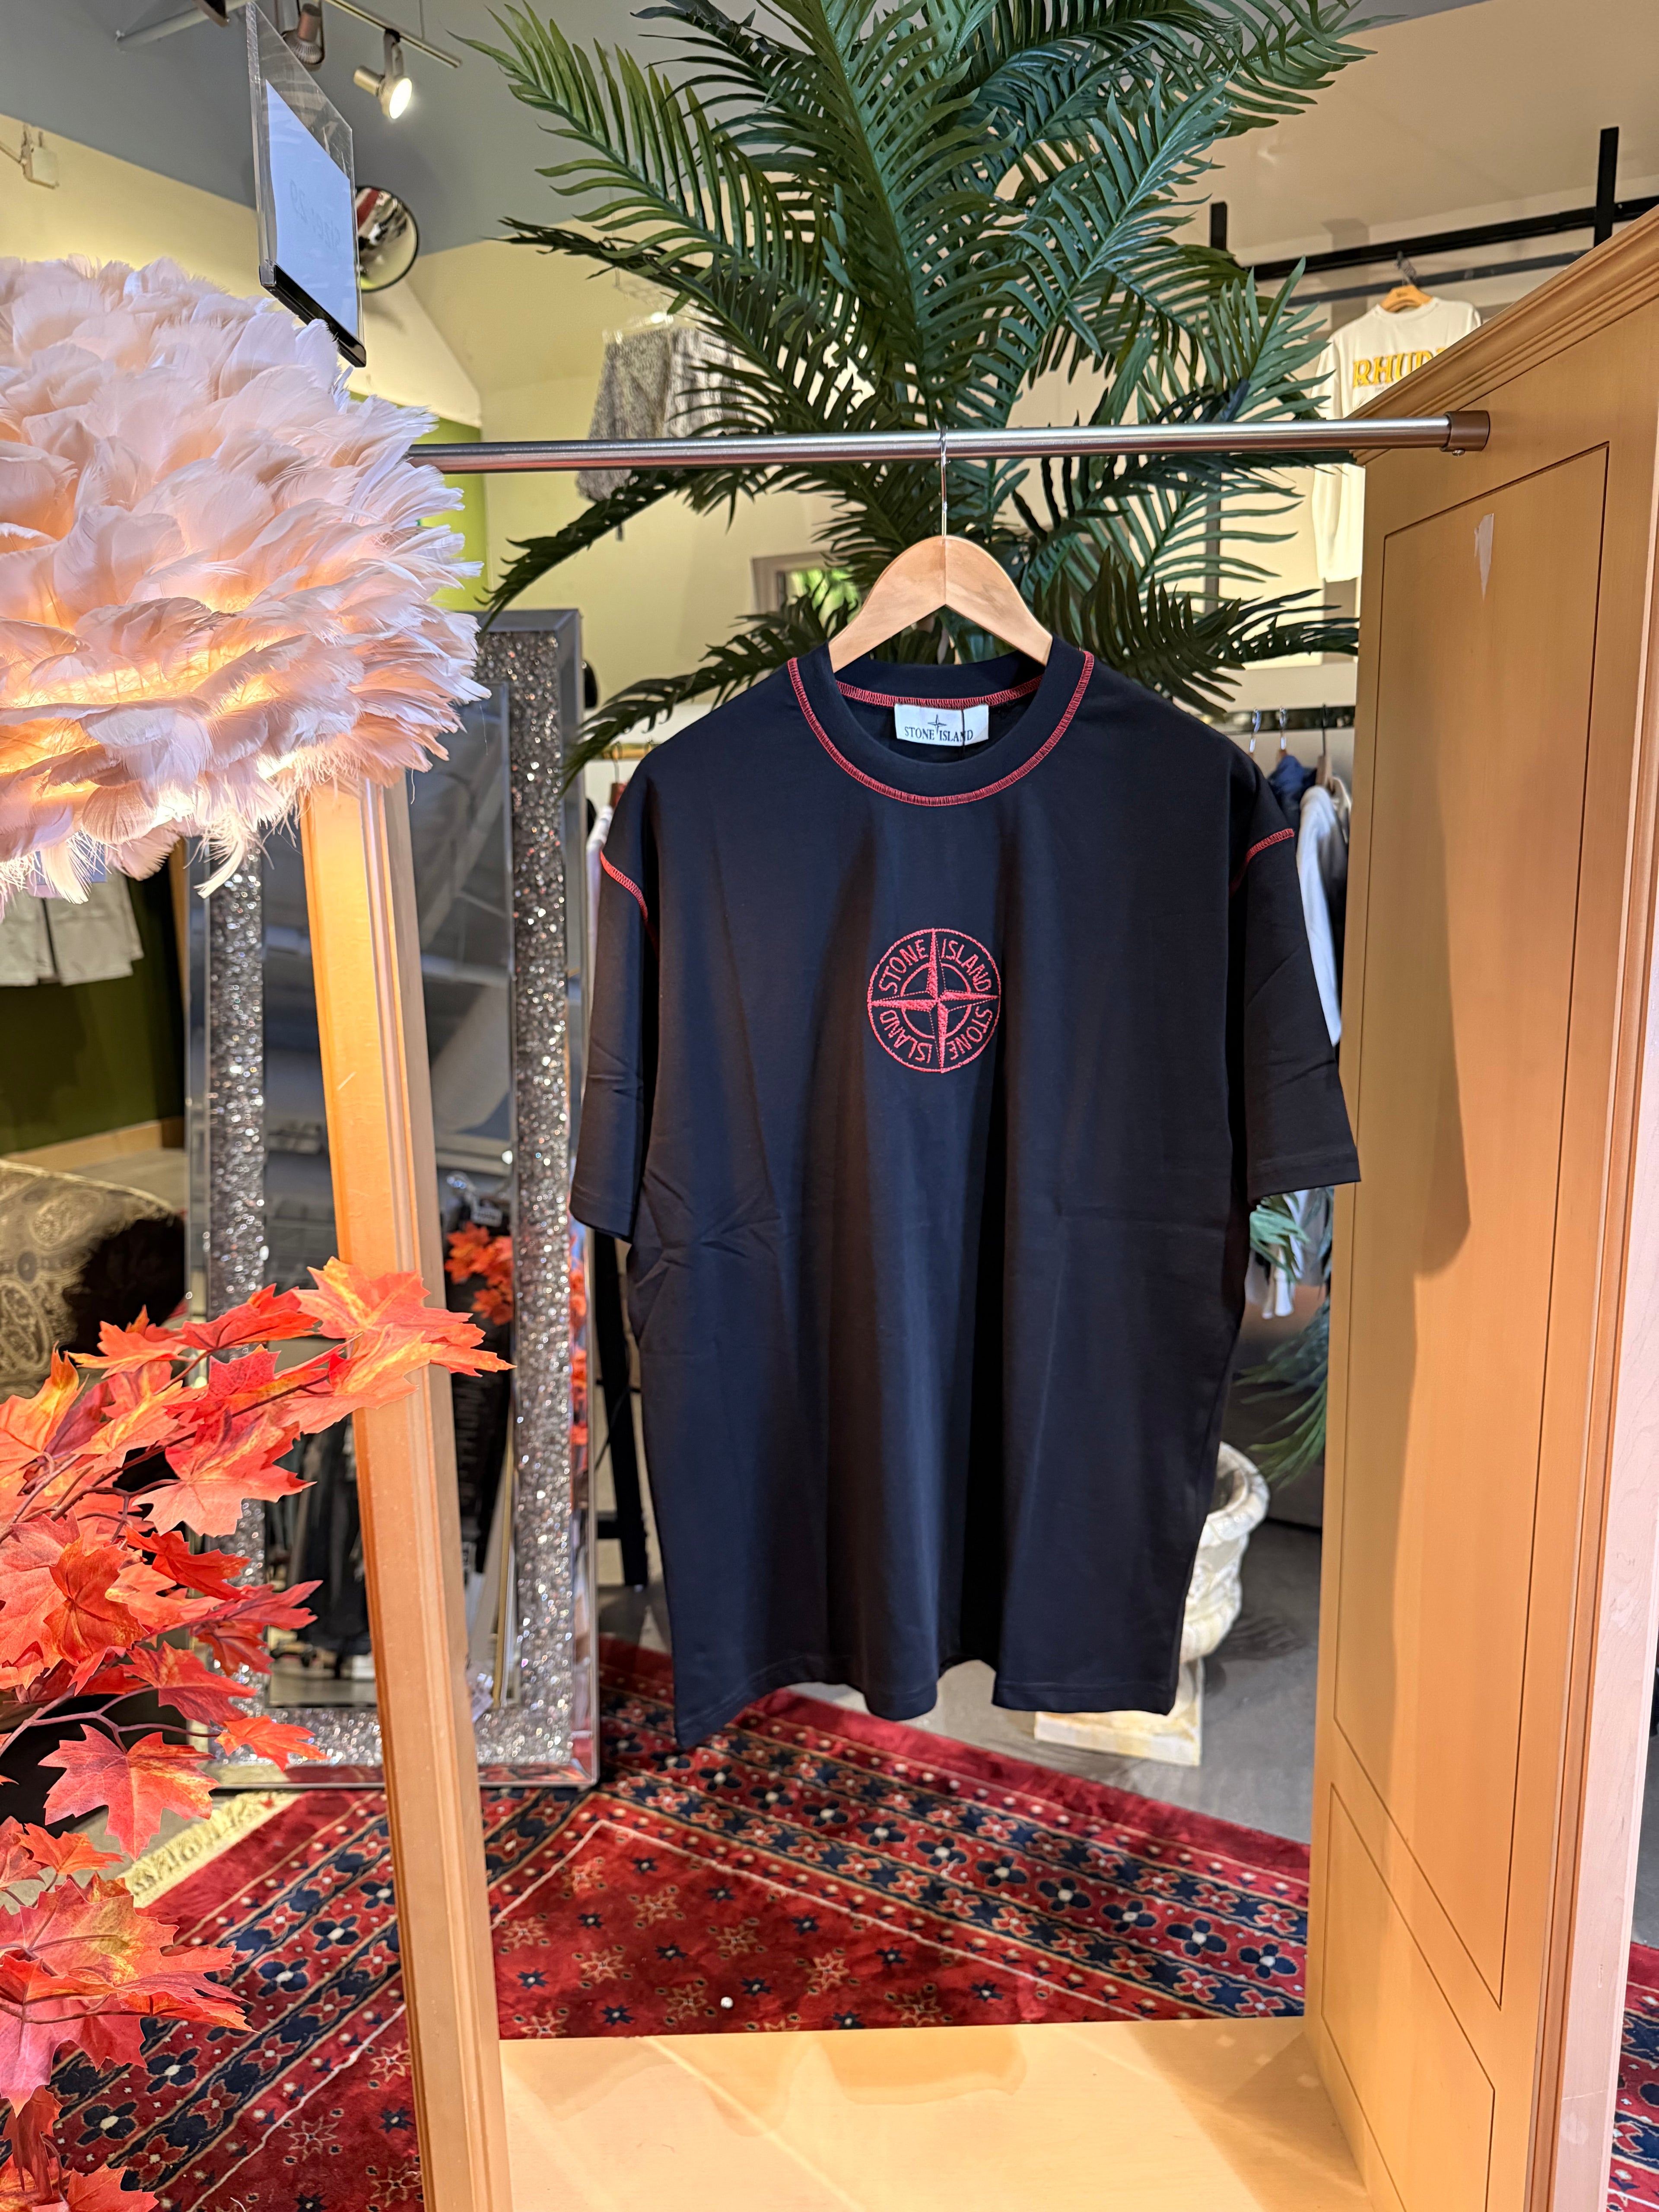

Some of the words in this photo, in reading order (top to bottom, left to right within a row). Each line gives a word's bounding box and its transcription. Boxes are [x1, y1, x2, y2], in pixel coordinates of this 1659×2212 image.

[1353, 347, 1447, 387] RHUD
[905, 726, 934, 740] STONE
[939, 729, 973, 742] ISLAND
[878, 939, 928, 994] STONE
[941, 938, 992, 992] ISLAND
[879, 1010, 932, 1064] ISLAND
[946, 1006, 993, 1061] STONE
